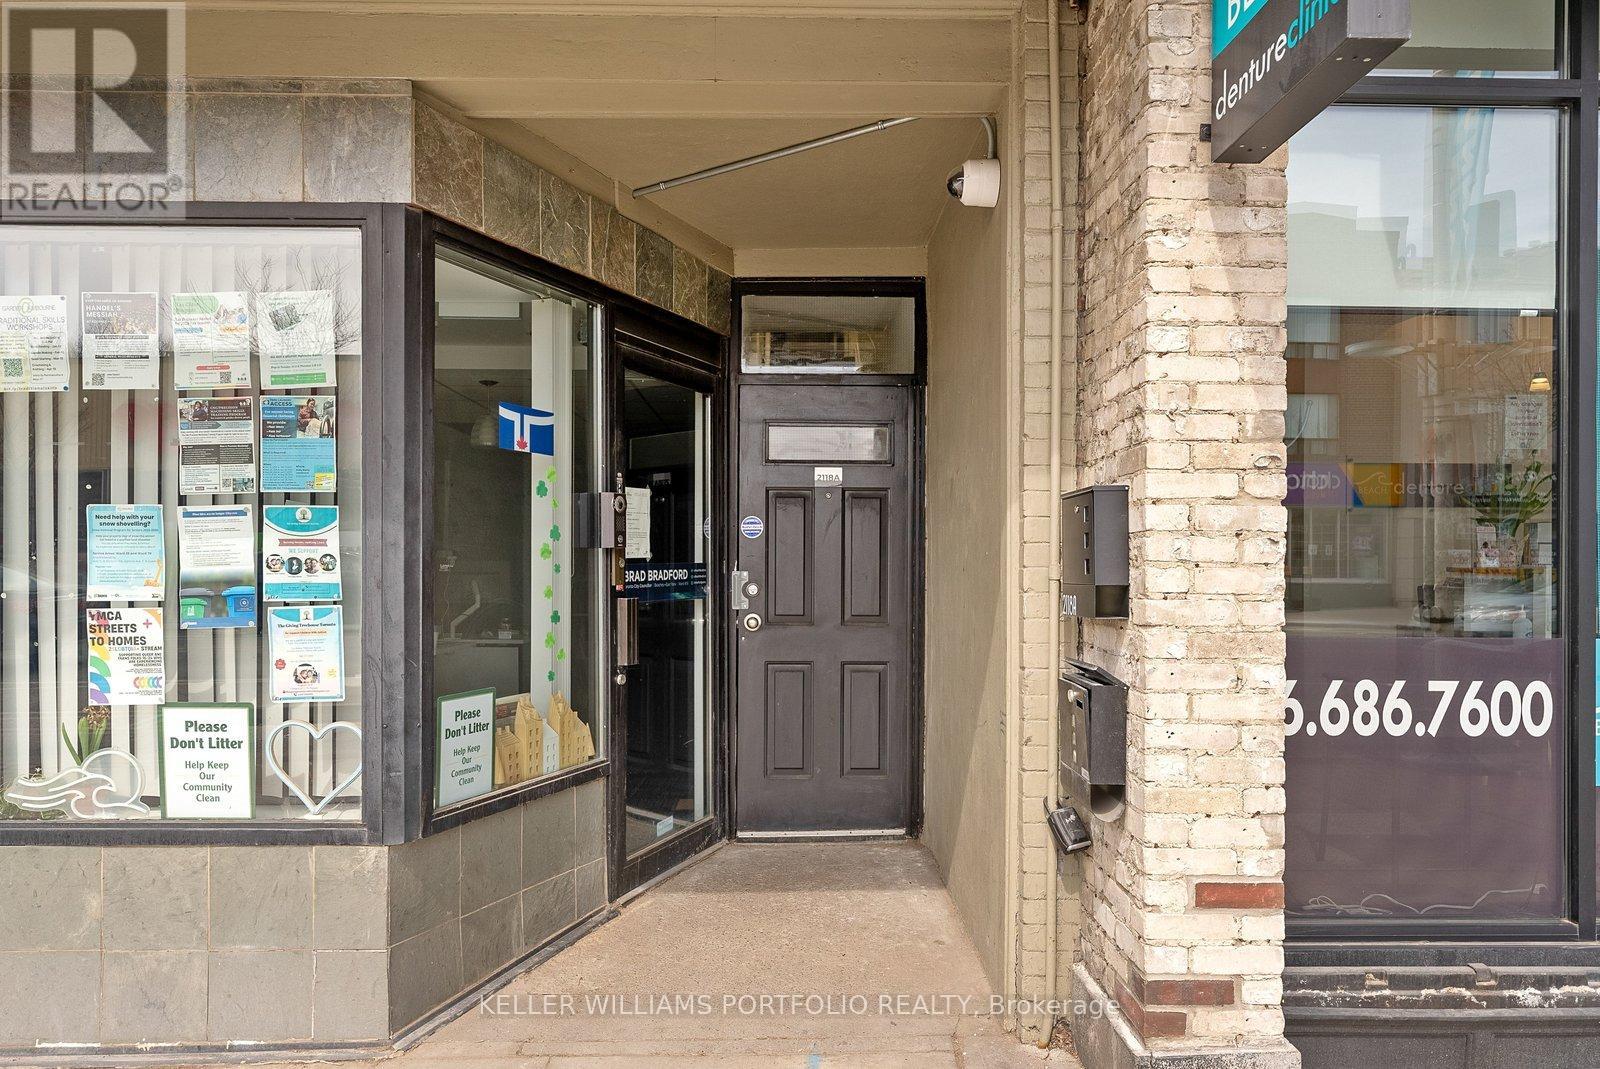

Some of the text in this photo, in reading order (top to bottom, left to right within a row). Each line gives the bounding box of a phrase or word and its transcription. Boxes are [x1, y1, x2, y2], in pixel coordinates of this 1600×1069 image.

[1215, 0, 1341, 120] dentureclini
[625, 570, 646, 582] BRAD
[648, 569, 688, 581] BRADFORD
[88, 611, 122, 620] YMCA
[89, 624, 137, 633] STREETS
[90, 636, 146, 646] TO HOMES
[455, 708, 481, 722] Please
[185, 720, 228, 732] Please
[445, 722, 490, 740] Don't Litter
[170, 737, 243, 749] Don't Litter
[453, 744, 480, 757] Help Keep
[185, 760, 229, 770] Help Keep
[462, 757, 472, 765] Our
[199, 772, 215, 780] Our
[451, 764, 482, 778] Community
[458, 777, 474, 786] Clean
[183, 783, 232, 792] Community
[196, 794, 220, 802] Clean
